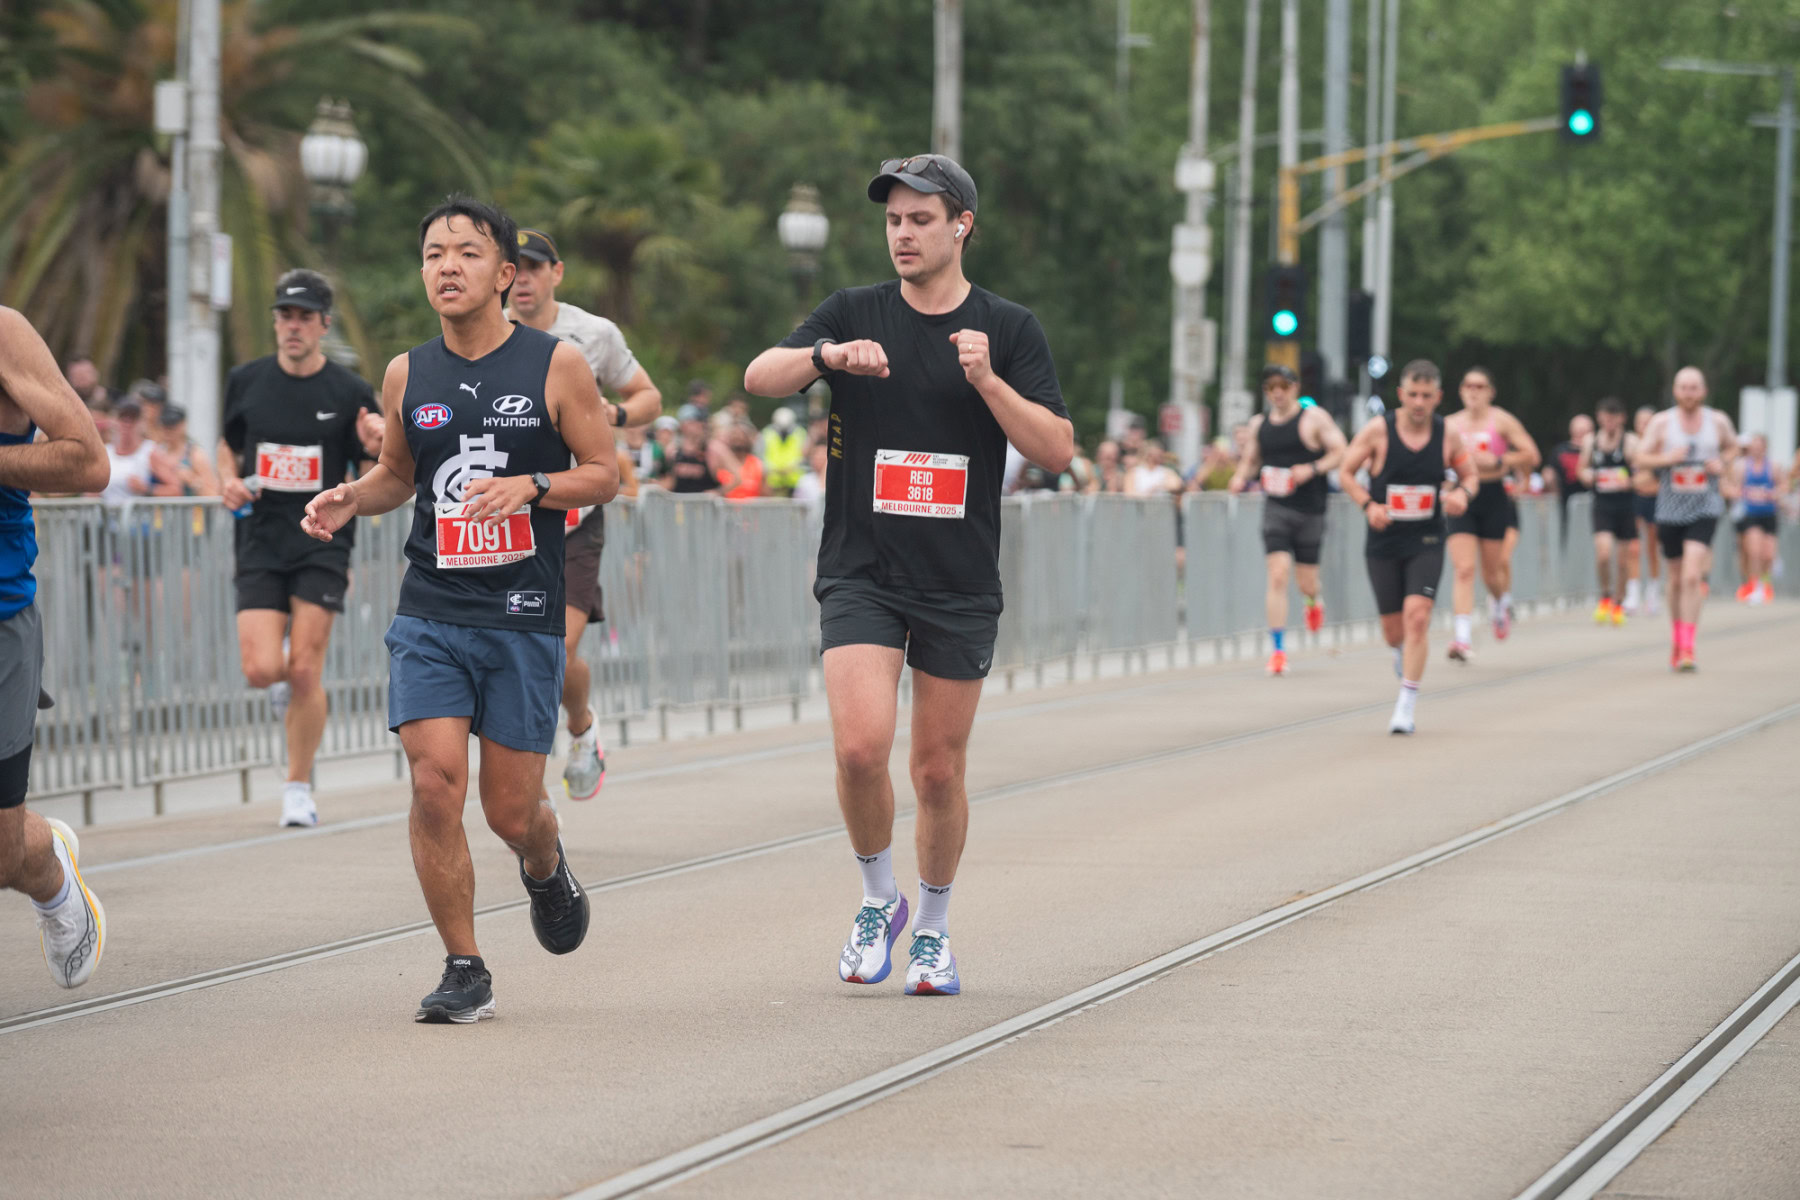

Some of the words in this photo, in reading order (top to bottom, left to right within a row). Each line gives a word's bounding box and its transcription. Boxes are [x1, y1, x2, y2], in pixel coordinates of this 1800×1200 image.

[417, 409, 449, 424] AFL
[483, 417, 540, 427] HYUNDAI
[831, 413, 843, 459] MAAP
[910, 470, 933, 485] REID
[907, 486, 933, 501] 3618
[881, 502, 932, 514] MELBOURNE
[935, 505, 957, 515] 2025
[452, 518, 513, 553] 7091
[446, 553, 499, 566] MELBOURNE
[501, 552, 526, 563] 2025
